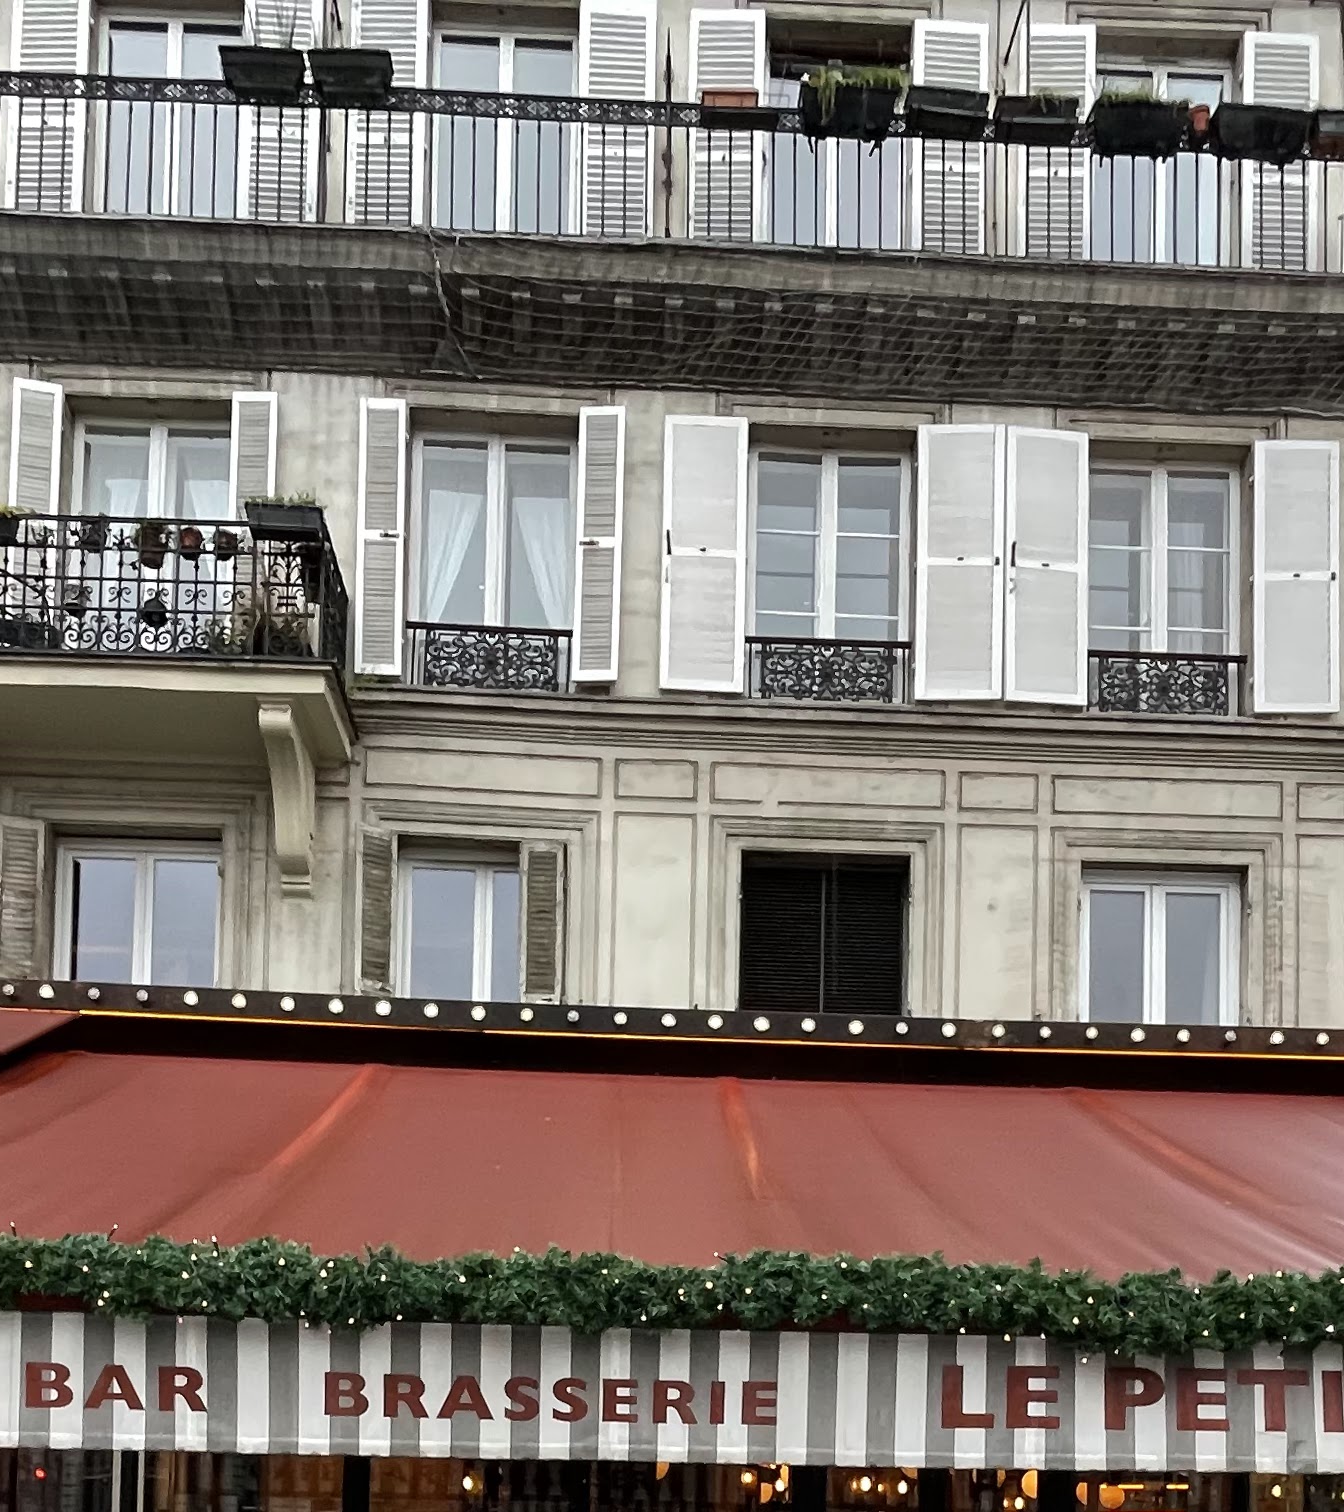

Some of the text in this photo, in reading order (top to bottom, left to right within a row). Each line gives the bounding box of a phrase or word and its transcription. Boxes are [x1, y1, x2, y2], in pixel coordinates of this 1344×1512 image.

[25, 1361, 208, 1412] BAR
[324, 1371, 779, 1426] BRASSERIE
[941, 1365, 1060, 1430] LE
